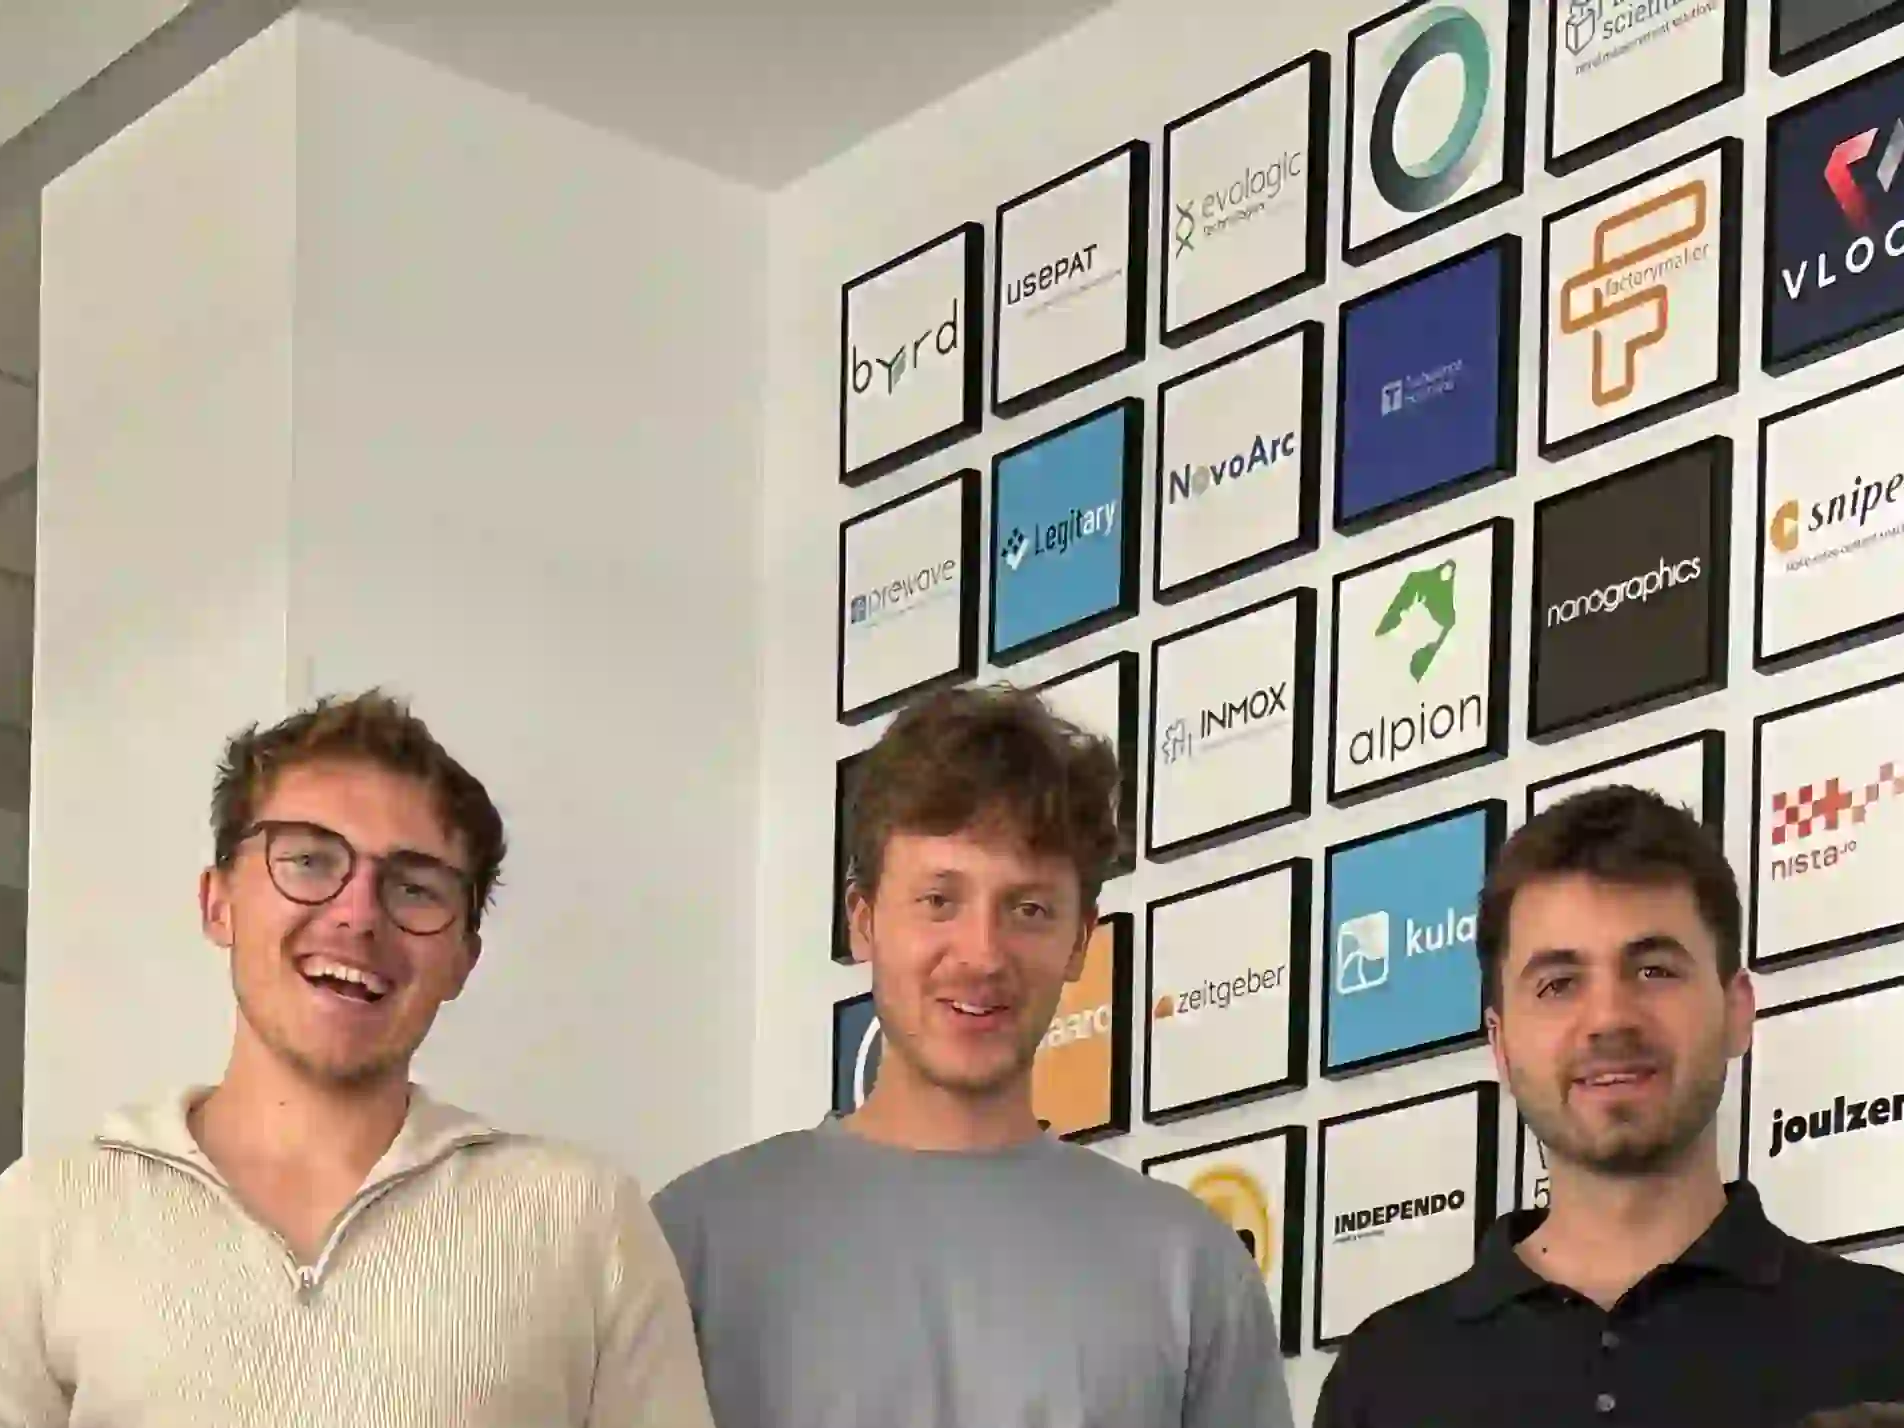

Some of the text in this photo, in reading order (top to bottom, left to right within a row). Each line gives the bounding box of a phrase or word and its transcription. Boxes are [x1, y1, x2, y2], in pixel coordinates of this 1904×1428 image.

[852, 297, 958, 396] byrd
[1034, 500, 1116, 555] Legitary
[868, 558, 956, 617] prewave
[1547, 555, 1701, 627] nanographics
[1201, 681, 1286, 739] INMOX
[1349, 694, 1481, 764] alpion
[1177, 965, 1286, 1013] zeitgeber
[1334, 1189, 1465, 1236] INDEPENDO
